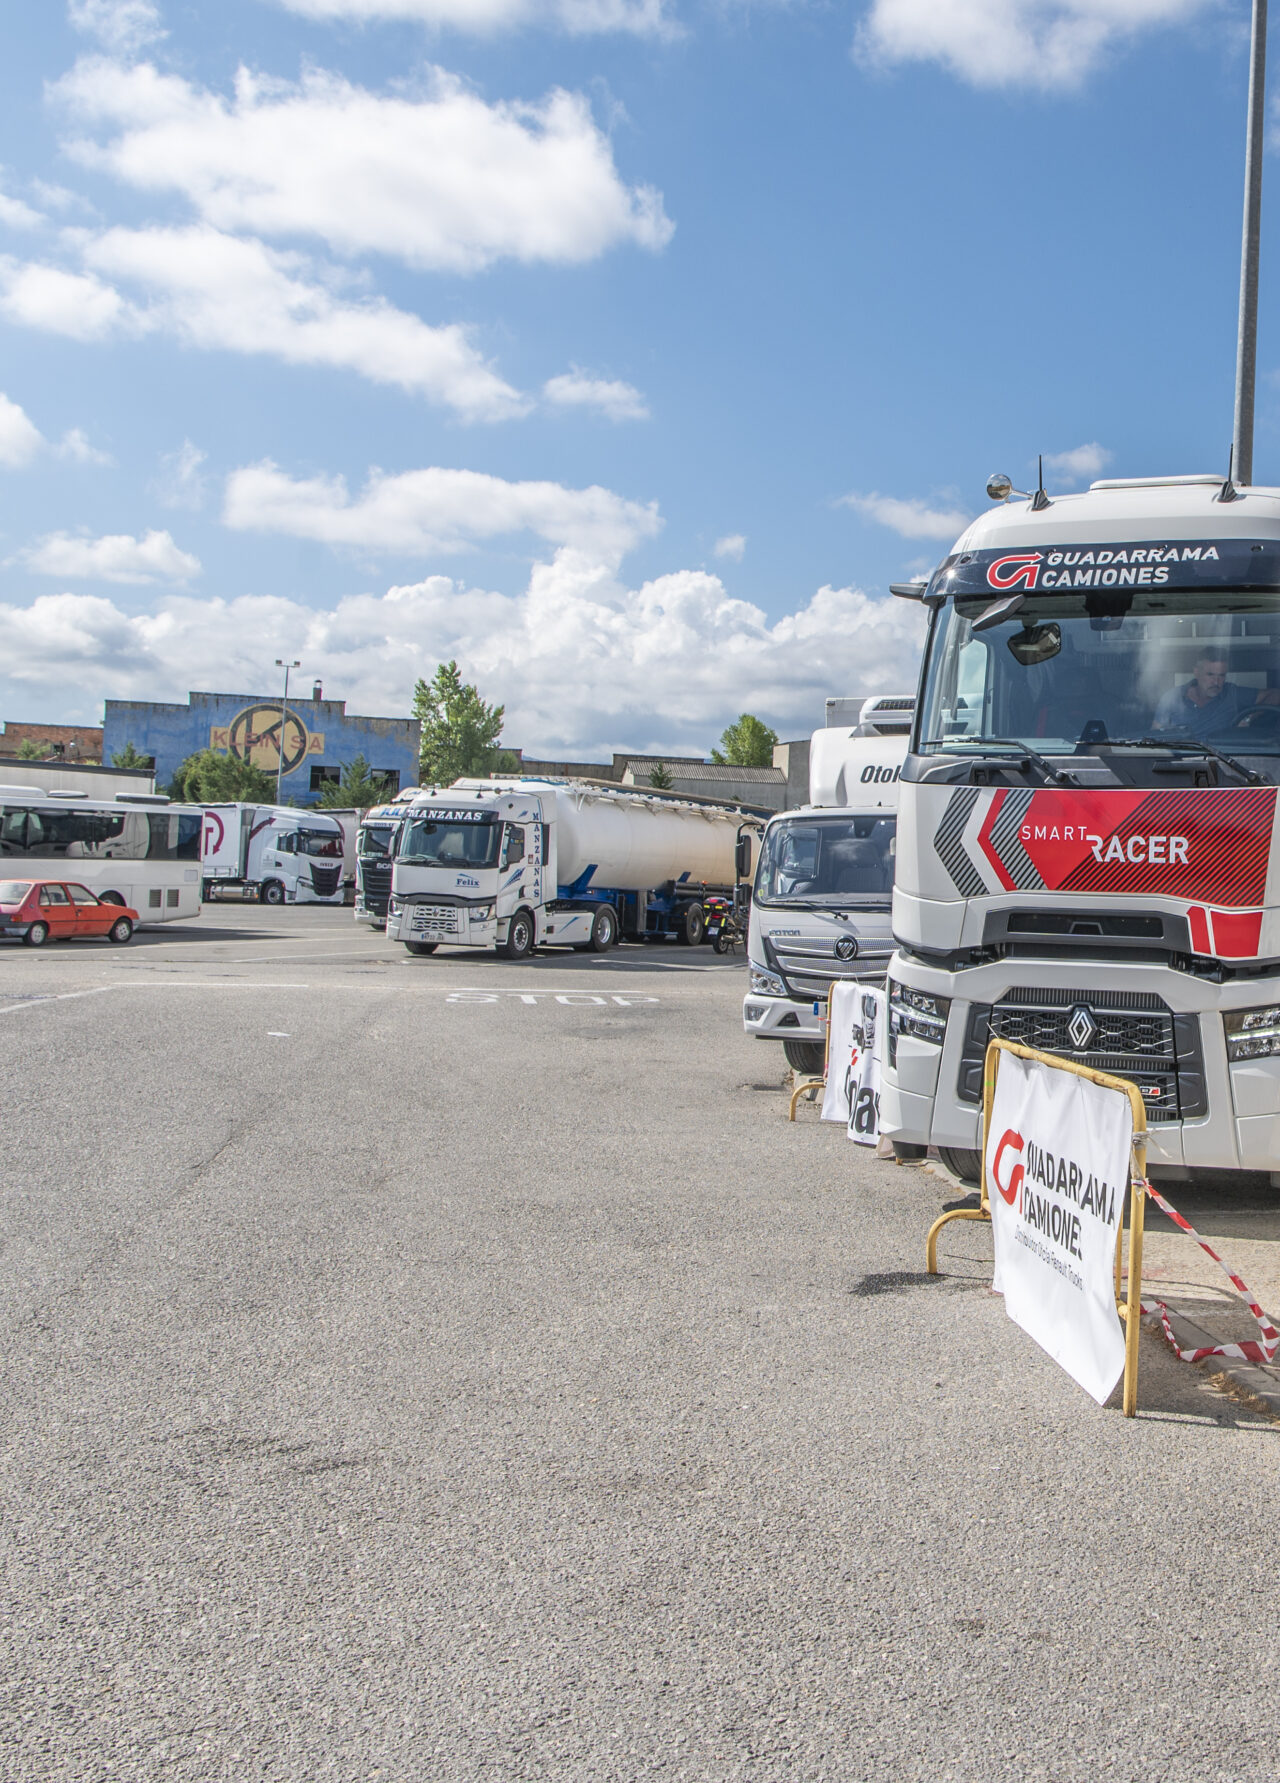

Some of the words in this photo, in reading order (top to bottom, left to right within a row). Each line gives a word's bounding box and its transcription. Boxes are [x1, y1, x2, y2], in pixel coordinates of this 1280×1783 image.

[1047, 546, 1220, 566] GUADARRAMA
[1041, 566, 1170, 588] CAMIONES
[213, 729, 281, 750] KLEIN
[407, 809, 483, 821] MANZANAS
[1021, 825, 1087, 841] SMART
[532, 812, 541, 898] MANZANAS
[1086, 834, 1190, 865] RACER
[456, 877, 480, 887] Felix
[446, 993, 660, 1006] STOP
